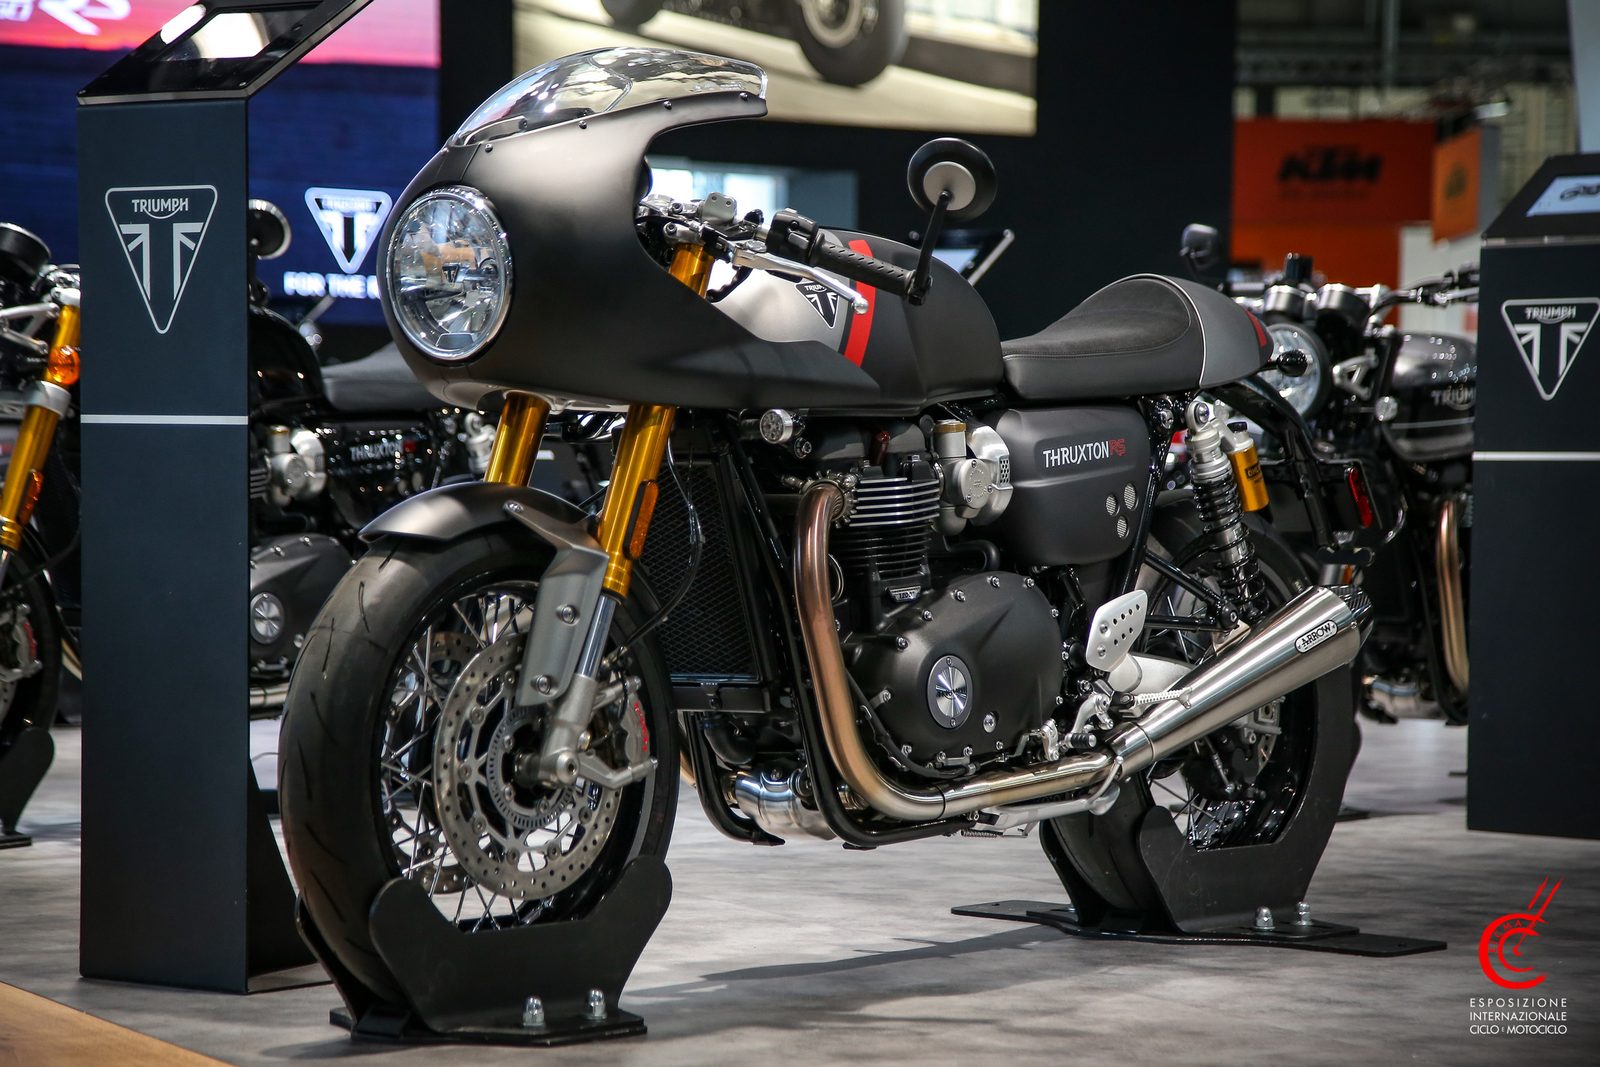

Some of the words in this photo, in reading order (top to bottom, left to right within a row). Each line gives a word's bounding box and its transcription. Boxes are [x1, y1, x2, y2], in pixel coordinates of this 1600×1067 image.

[131, 197, 189, 219] TRIUMPH
[1525, 305, 1577, 324] TRIUMPH
[1042, 440, 1110, 468] THRUXTON
[1301, 622, 1331, 648] ARROW
